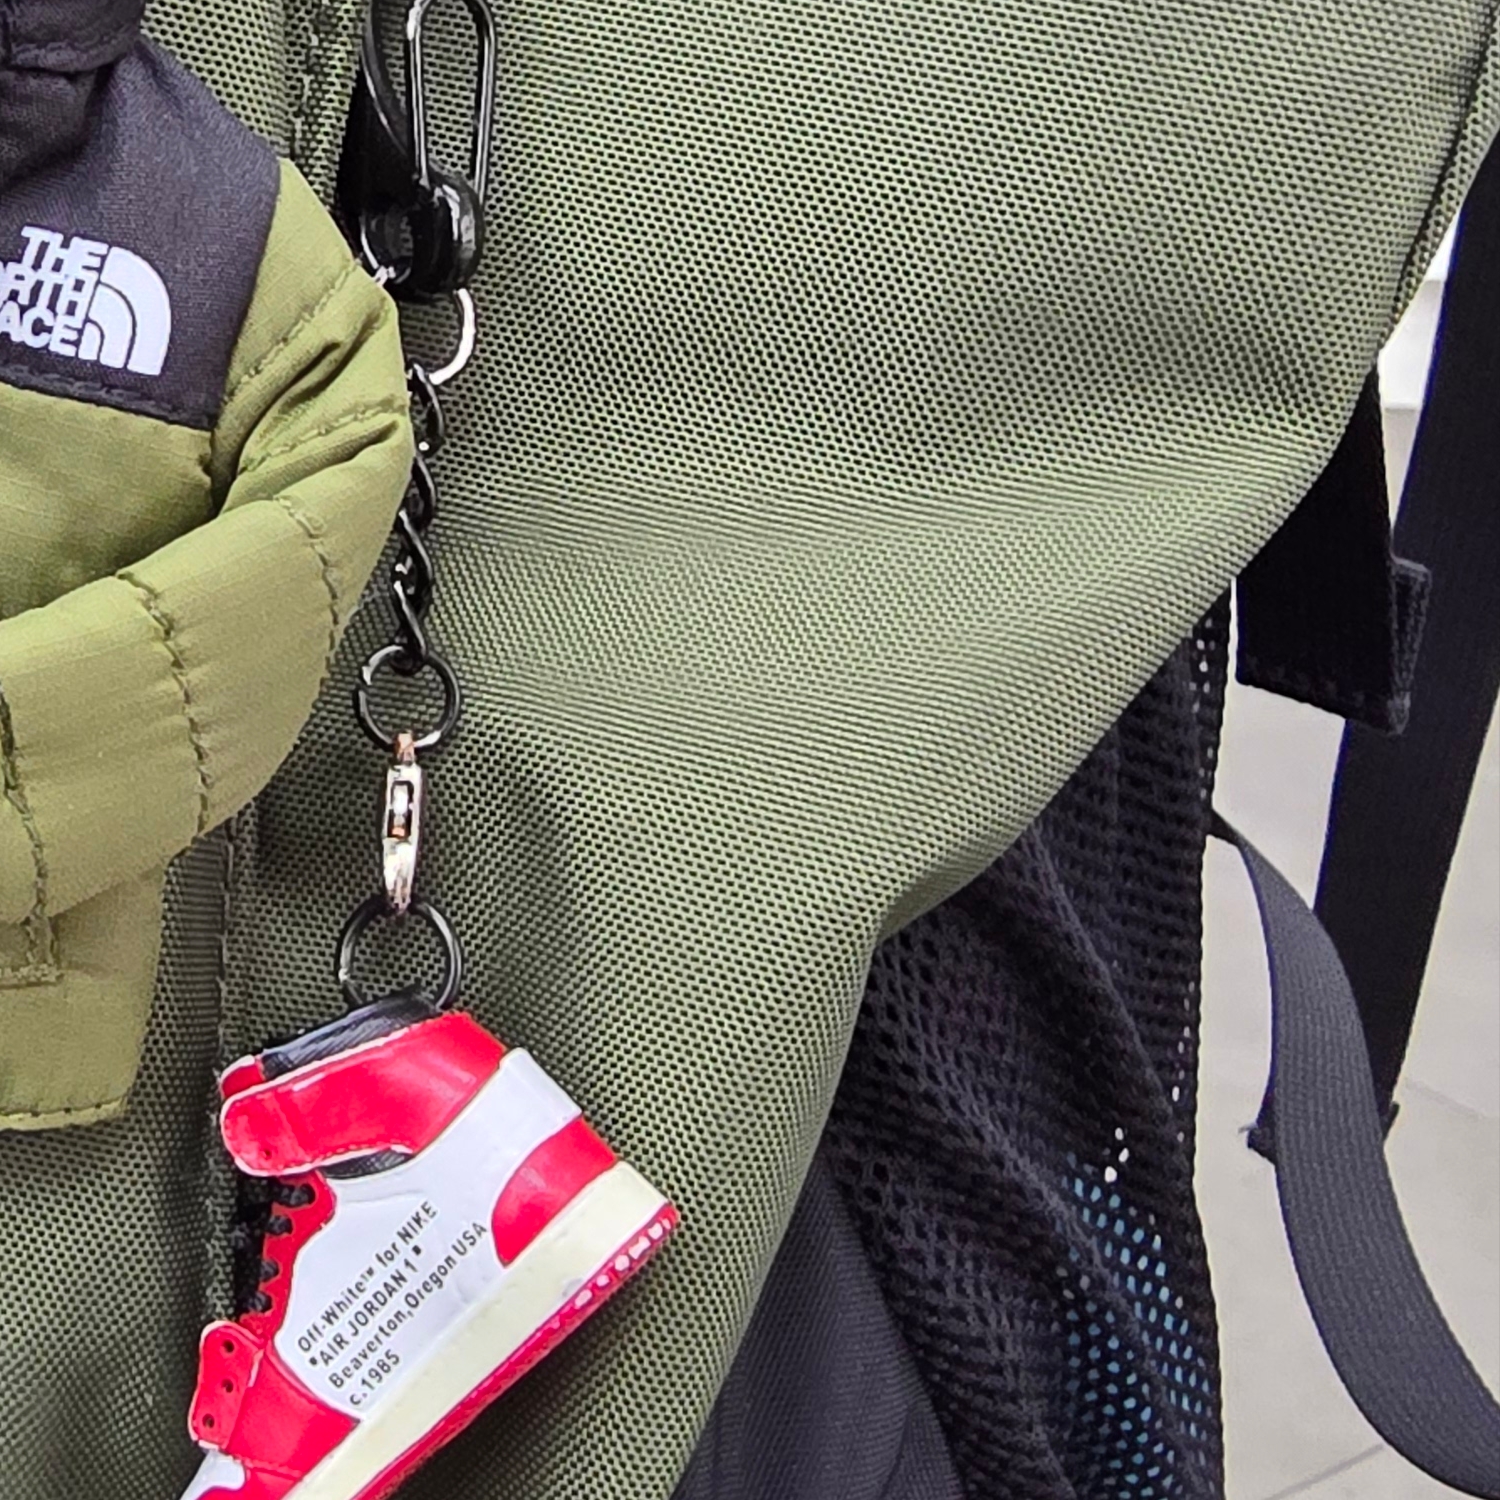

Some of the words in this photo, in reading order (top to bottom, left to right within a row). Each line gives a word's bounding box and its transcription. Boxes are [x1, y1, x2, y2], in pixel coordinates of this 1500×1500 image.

[20, 226, 109, 272] THE
[375, 1242, 401, 1268] for
[397, 1201, 438, 1246] NIKE
[452, 1221, 488, 1257] USA
[350, 1269, 409, 1338] JORDAN
